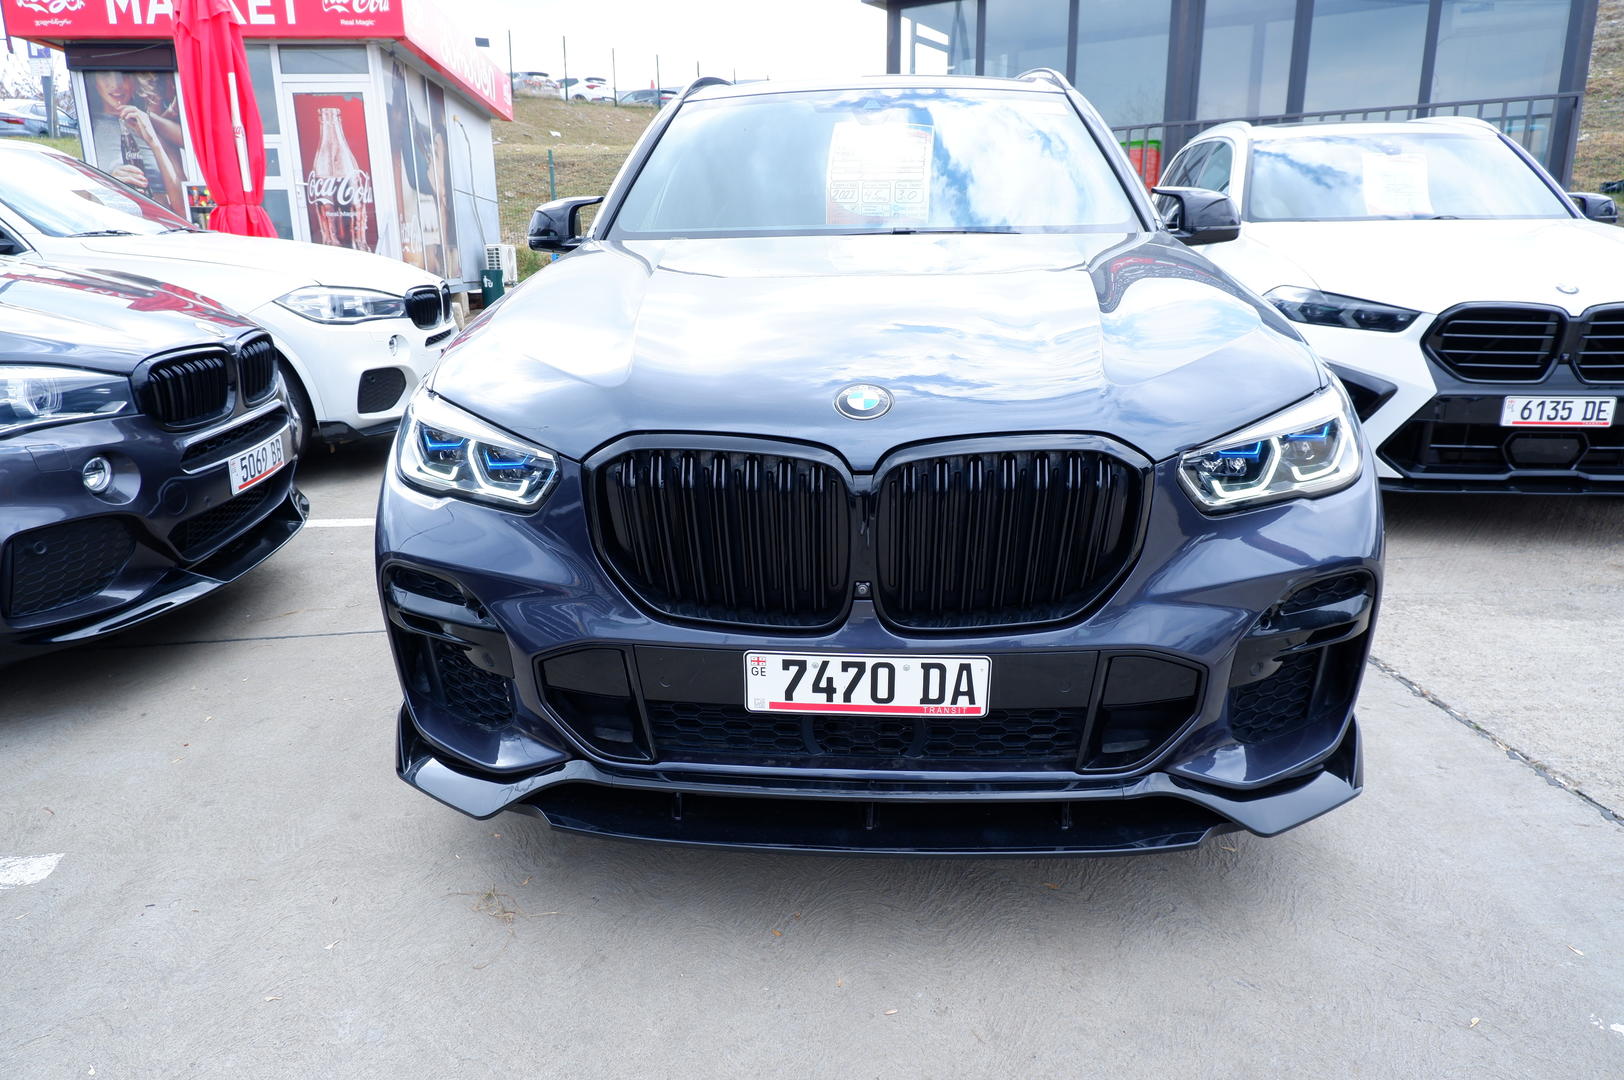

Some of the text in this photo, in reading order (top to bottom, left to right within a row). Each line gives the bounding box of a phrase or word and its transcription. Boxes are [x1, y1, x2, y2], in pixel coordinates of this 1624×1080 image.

[106, 0, 297, 25] MAE
[307, 169, 373, 205] Coca-Cola
[1520, 400, 1574, 421] 6135
[1581, 400, 1610, 421] DE
[239, 447, 268, 482] 5069
[751, 666, 766, 677] GE
[781, 658, 976, 706] 7470 DA
[923, 706, 968, 715] TRANSIT
